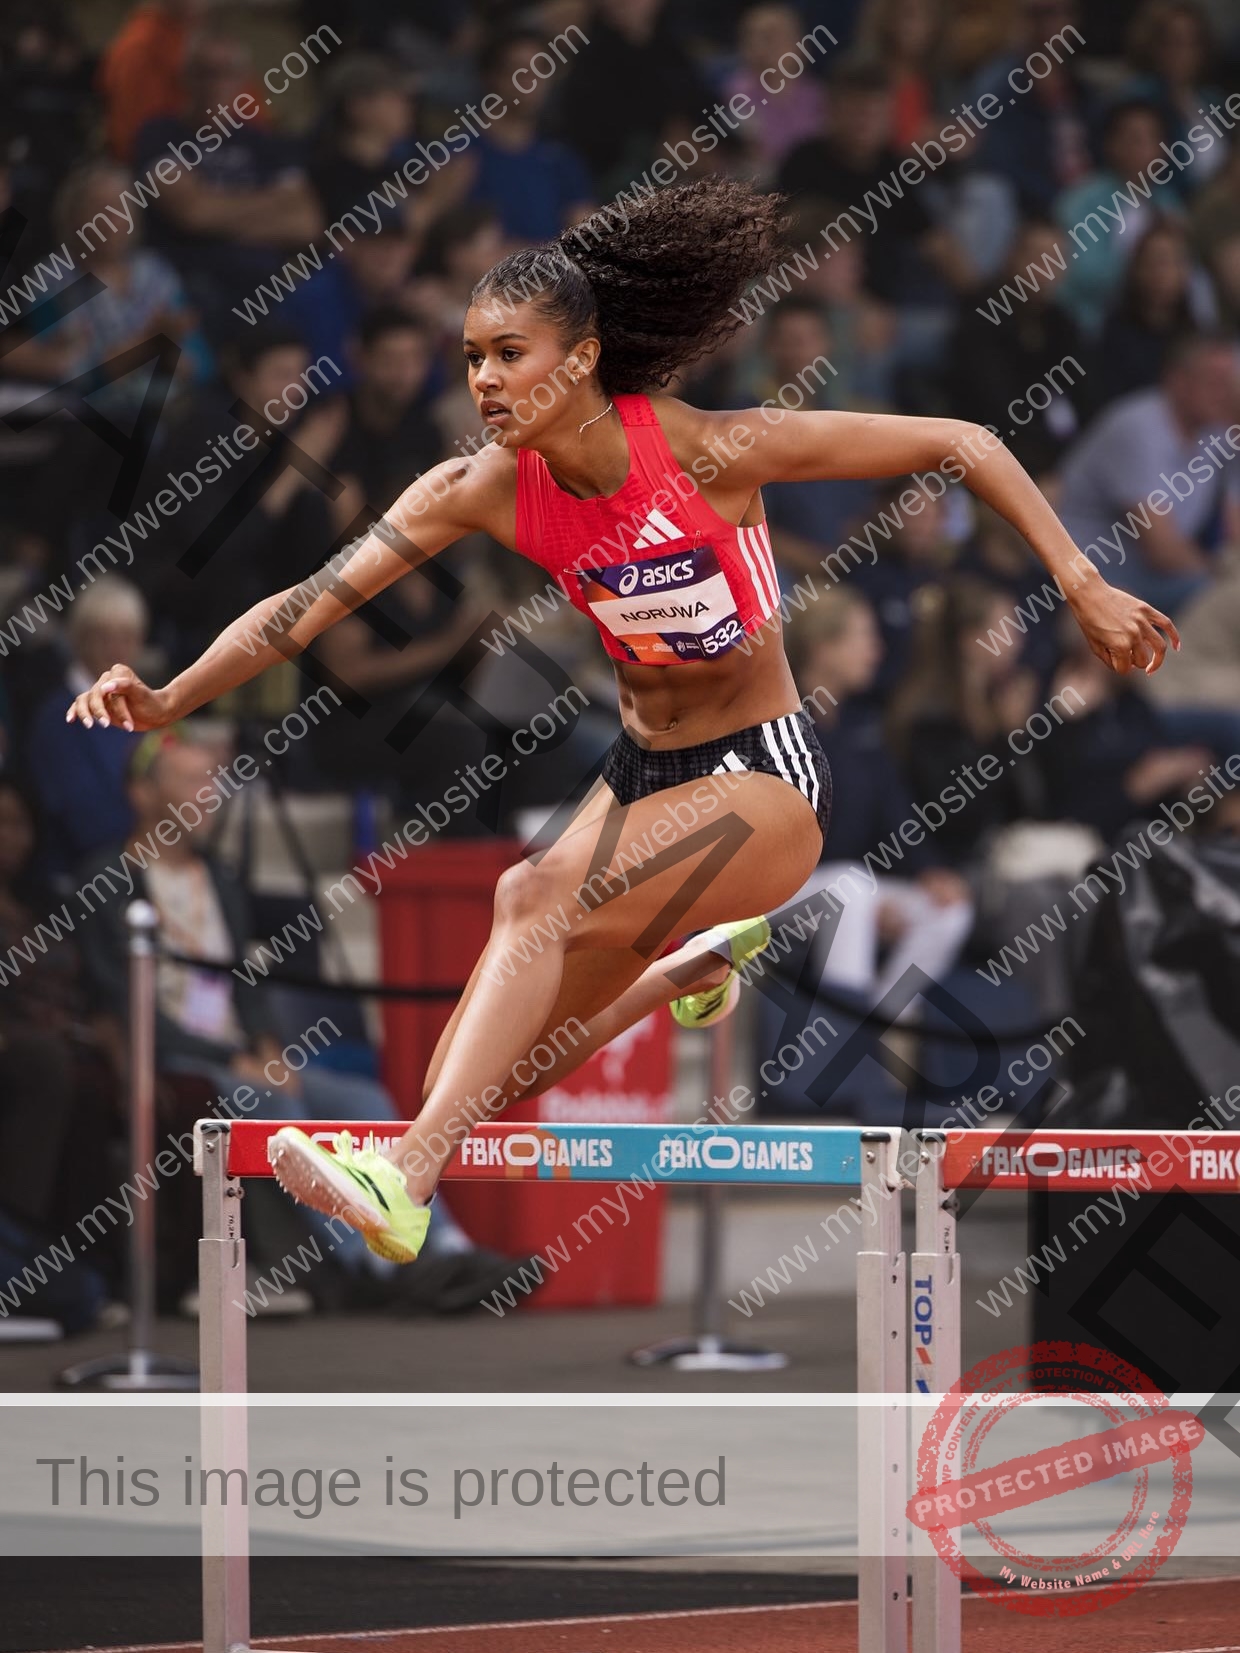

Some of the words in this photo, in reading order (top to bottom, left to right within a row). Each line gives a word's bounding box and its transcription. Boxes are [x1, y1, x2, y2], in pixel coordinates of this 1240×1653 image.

[620, 601, 710, 622] NORUWA
[701, 620, 742, 654] 532
[914, 1275, 932, 1346] TOP
